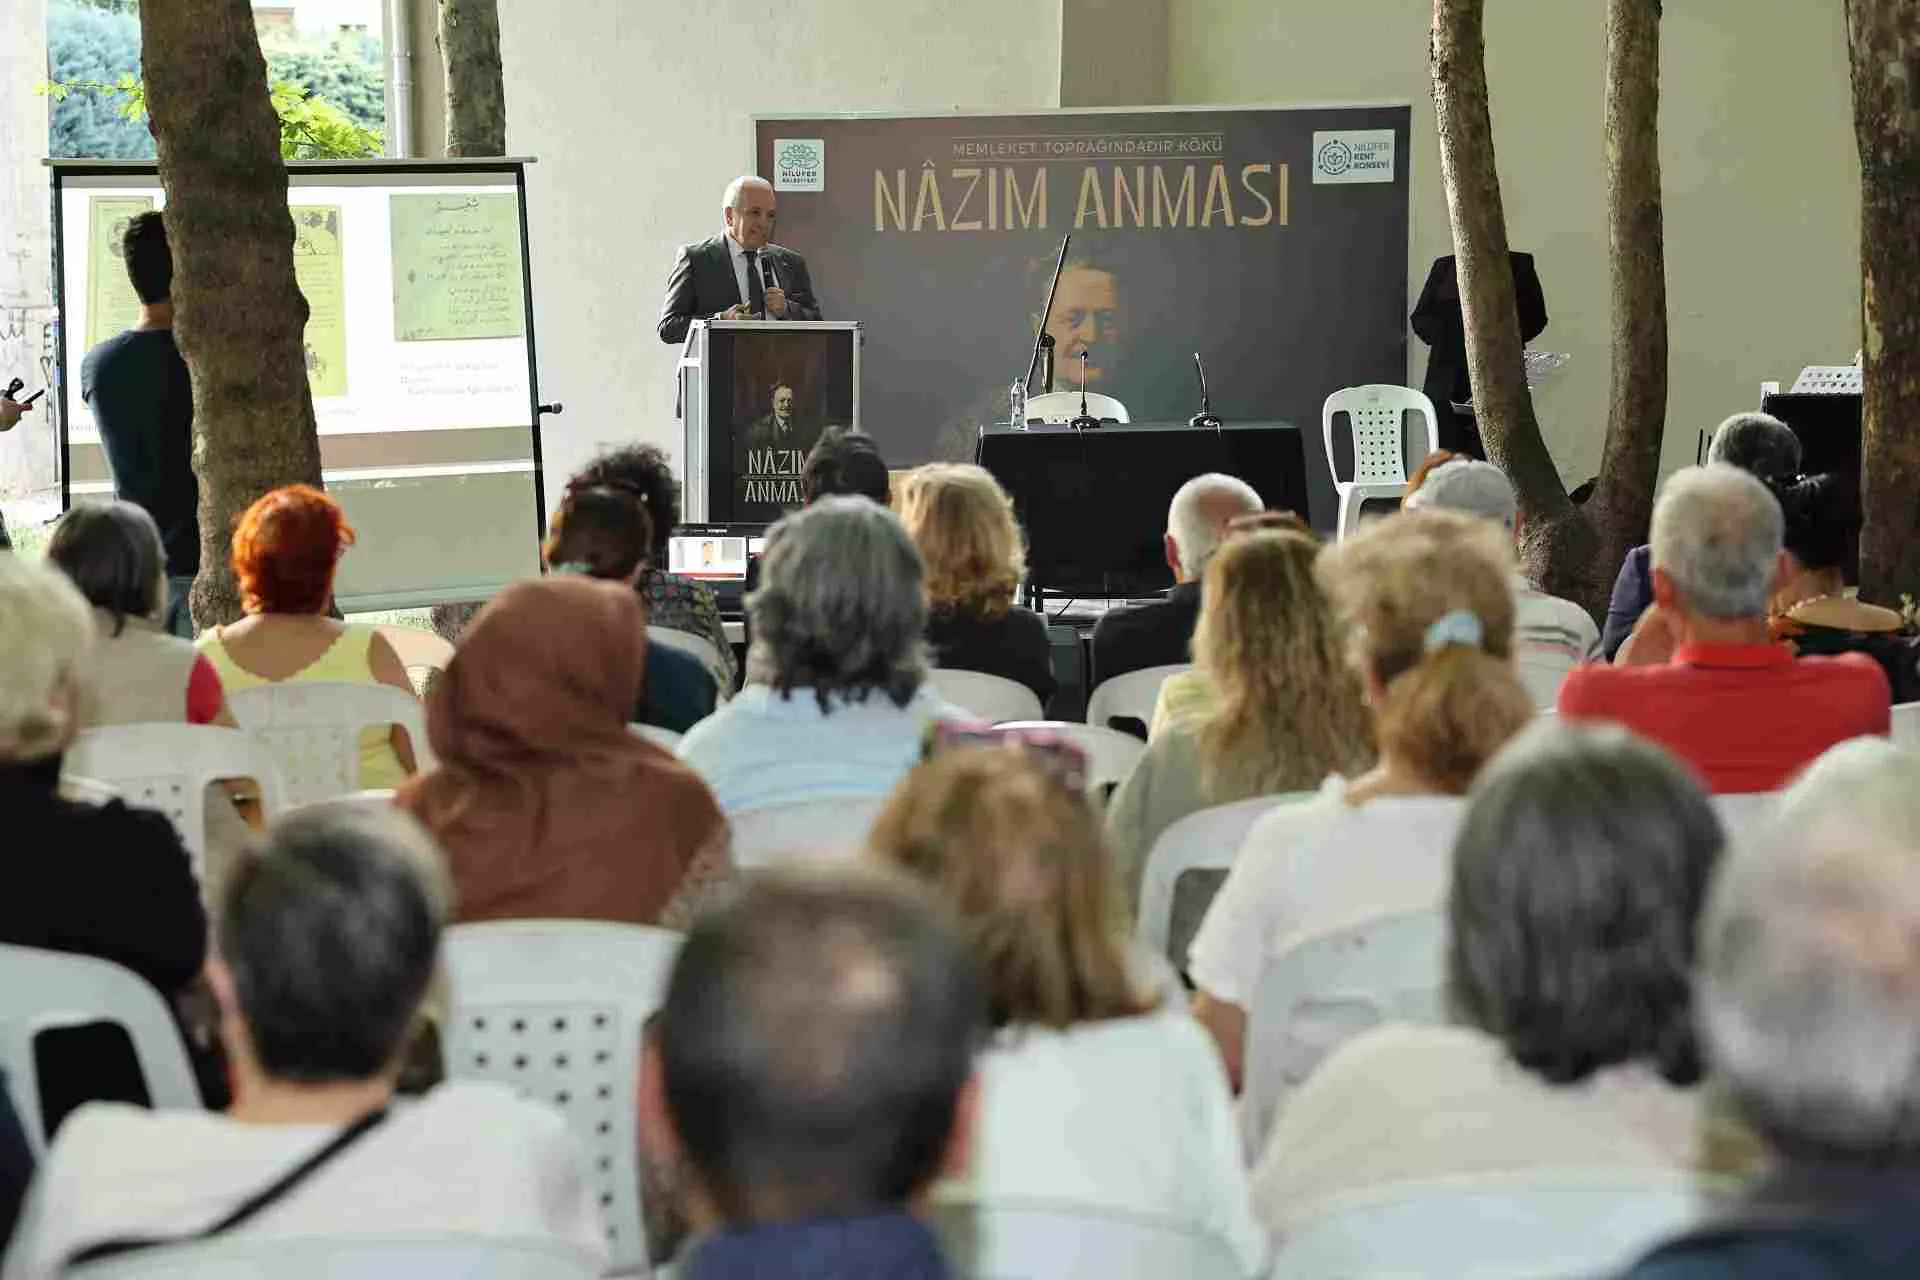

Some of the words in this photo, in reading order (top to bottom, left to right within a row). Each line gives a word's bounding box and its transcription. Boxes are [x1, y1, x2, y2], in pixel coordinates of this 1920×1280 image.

[952, 142, 1037, 156] MEMLEKET
[874, 160, 1047, 231] NÂZIM
[1073, 161, 1290, 230] ANMASI
